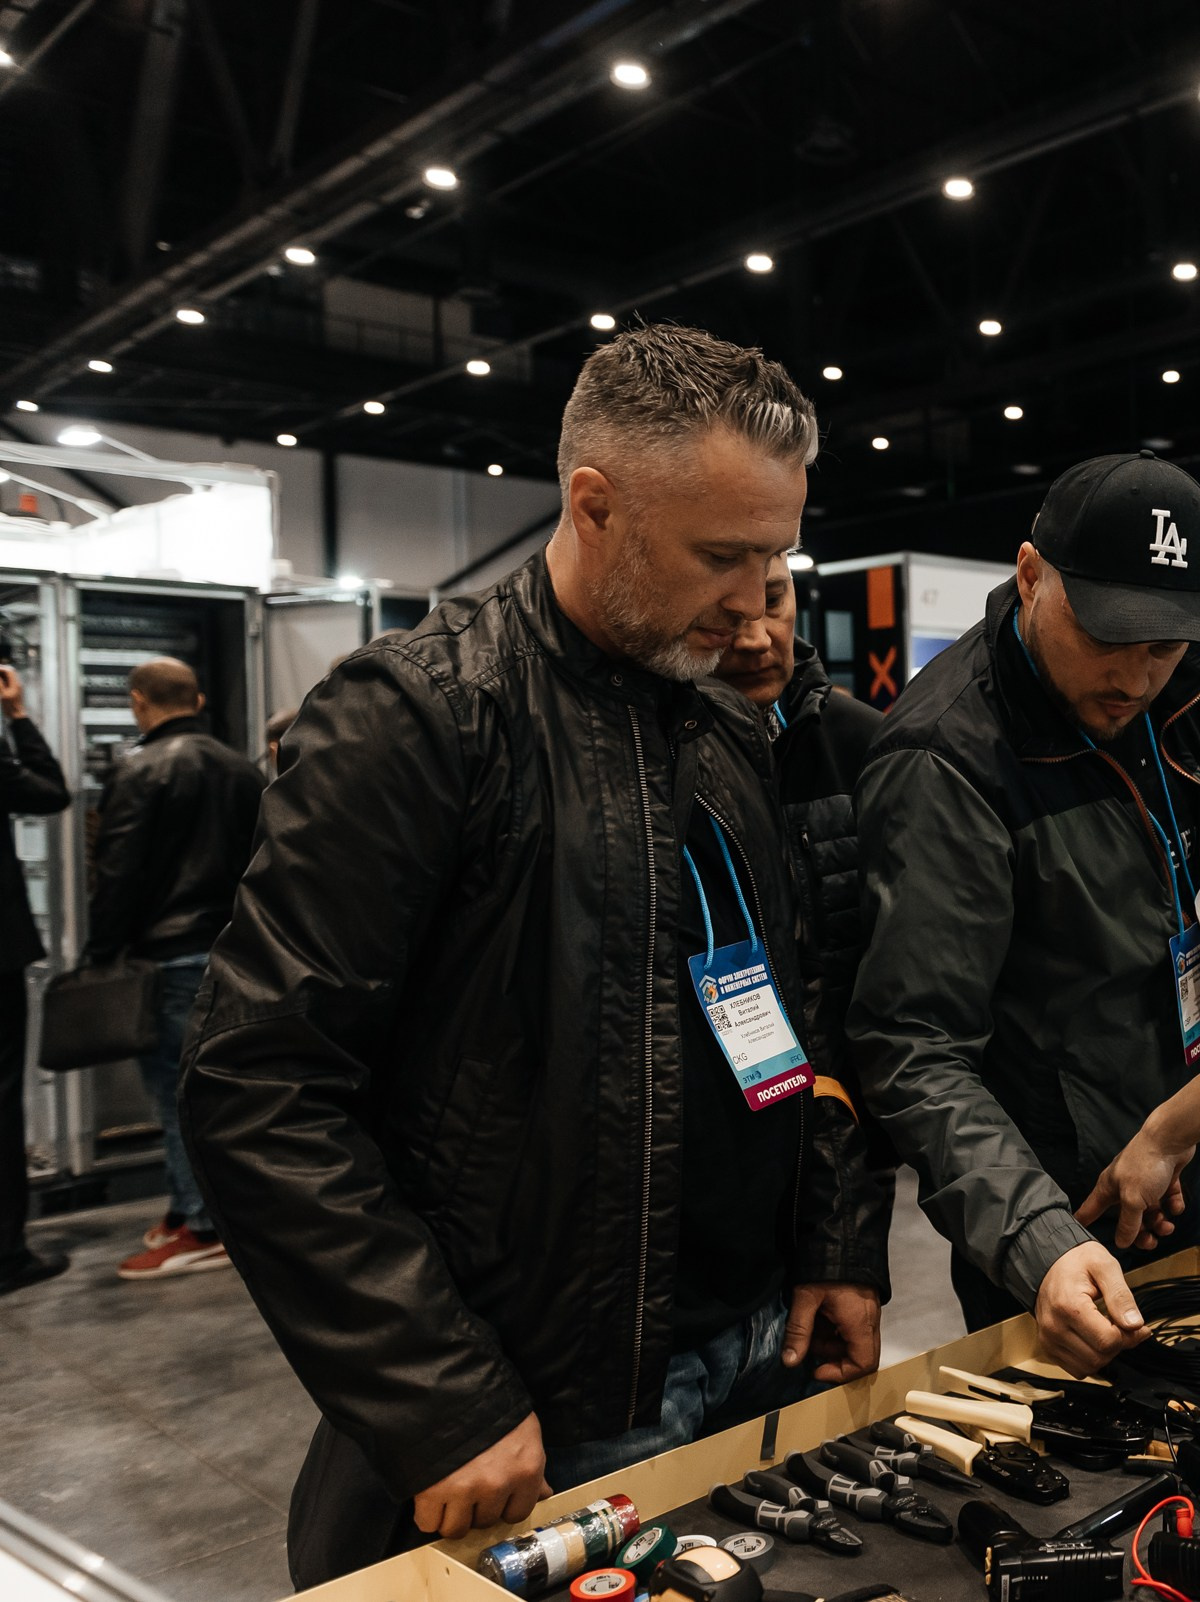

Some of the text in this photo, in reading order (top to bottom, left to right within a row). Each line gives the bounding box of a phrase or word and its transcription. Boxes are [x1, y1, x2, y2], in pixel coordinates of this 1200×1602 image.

[1149, 508, 1188, 568] LA
[730, 993, 761, 1009] ХЛЕБНИКОВ
[738, 1004, 759, 1016] Виталий
[734, 1010, 771, 1027] Александрович
[742, 1073, 756, 1084] ЭТМ
[756, 1073, 807, 1103] ПОСЕТИТЕЛЬ
